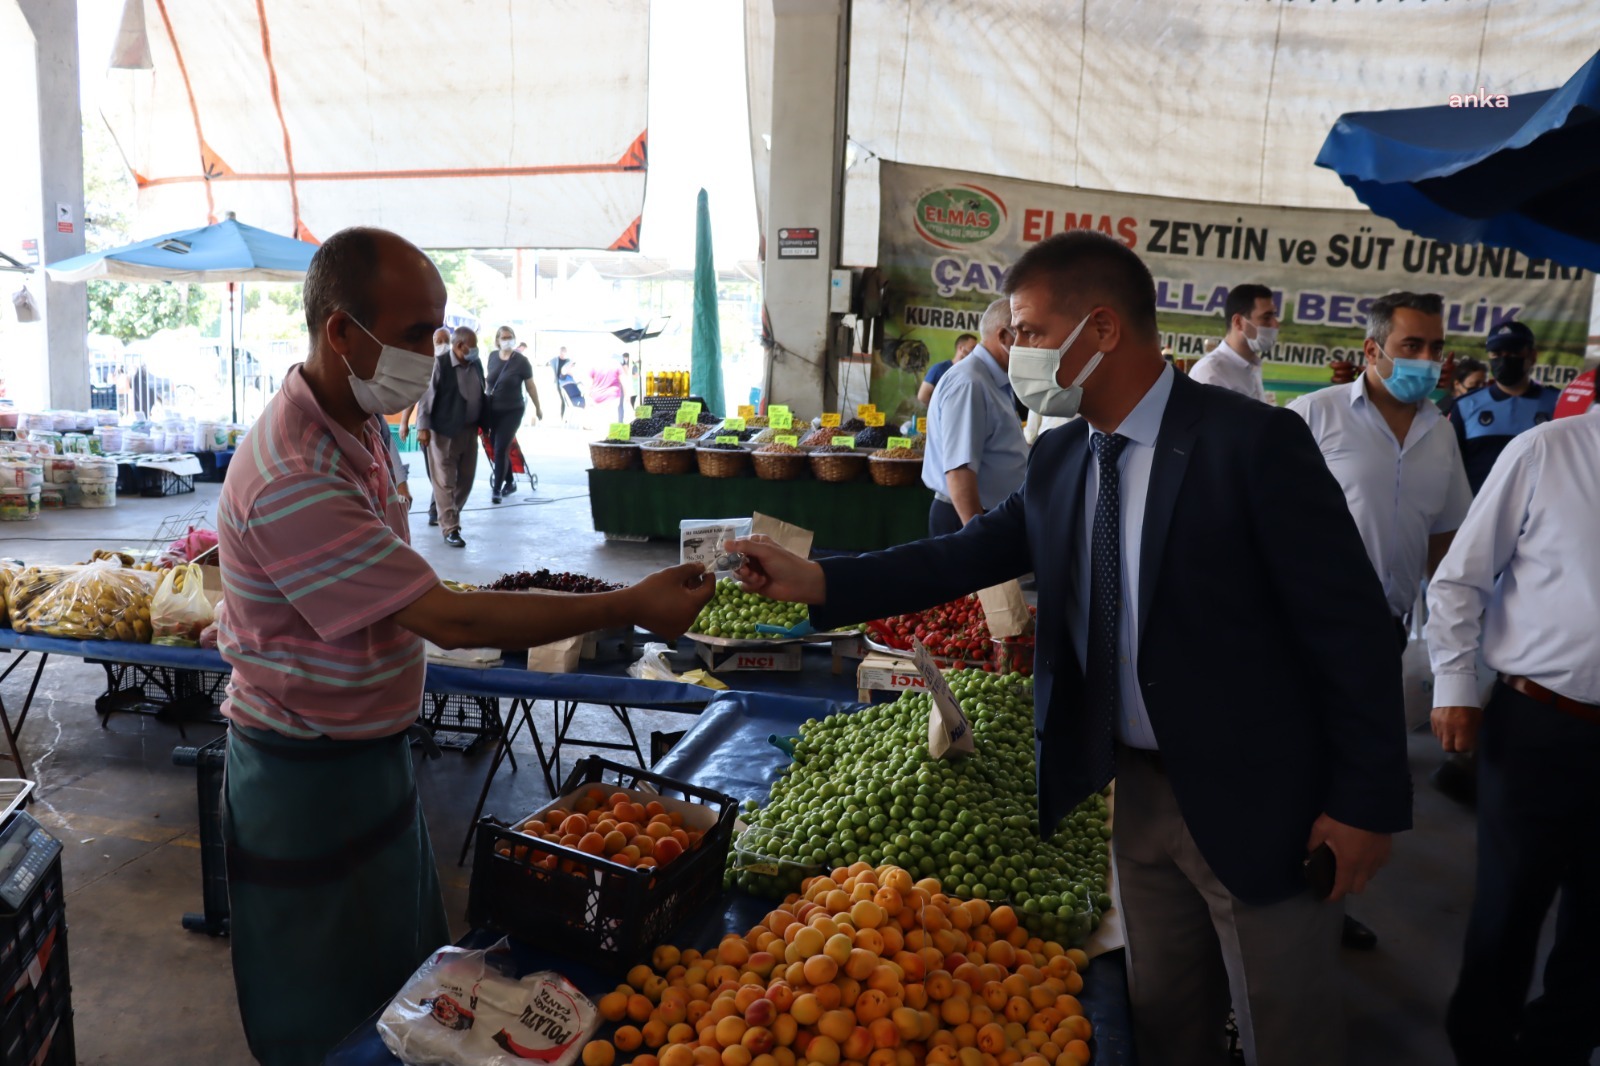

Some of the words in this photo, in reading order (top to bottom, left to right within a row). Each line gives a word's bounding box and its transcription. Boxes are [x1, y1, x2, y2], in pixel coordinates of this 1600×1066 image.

[924, 204, 991, 229] ELMAS
[1146, 216, 1268, 262] ZEYTİN
[1278, 238, 1317, 265] ve
[1326, 226, 1395, 271] SÜT
[905, 306, 985, 332] KURBAN
[891, 674, 927, 688] NCİ
